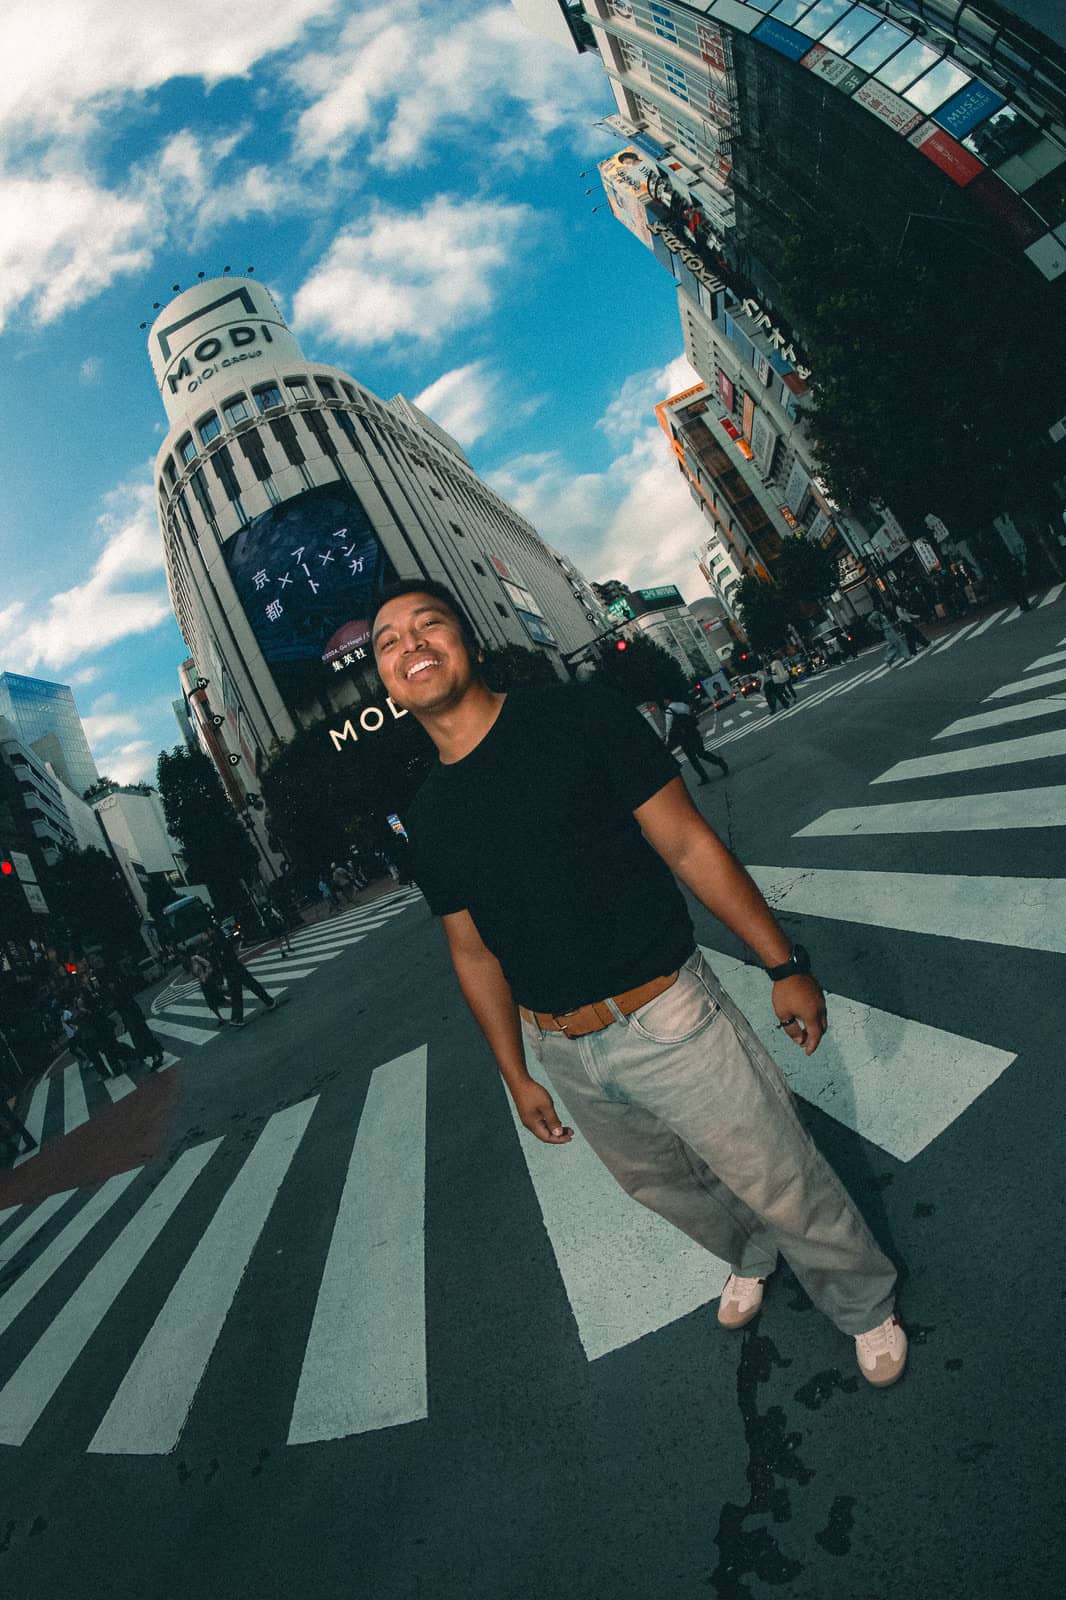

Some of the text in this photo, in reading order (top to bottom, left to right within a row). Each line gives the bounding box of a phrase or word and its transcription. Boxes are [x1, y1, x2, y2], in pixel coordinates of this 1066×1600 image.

[845, 75, 859, 90] 3F
[646, 219, 727, 294] KARAOKE
[167, 324, 273, 394] MODI
[290, 546, 320, 595] アート
[332, 528, 365, 577] マンガ
[251, 568, 285, 623] 京都
